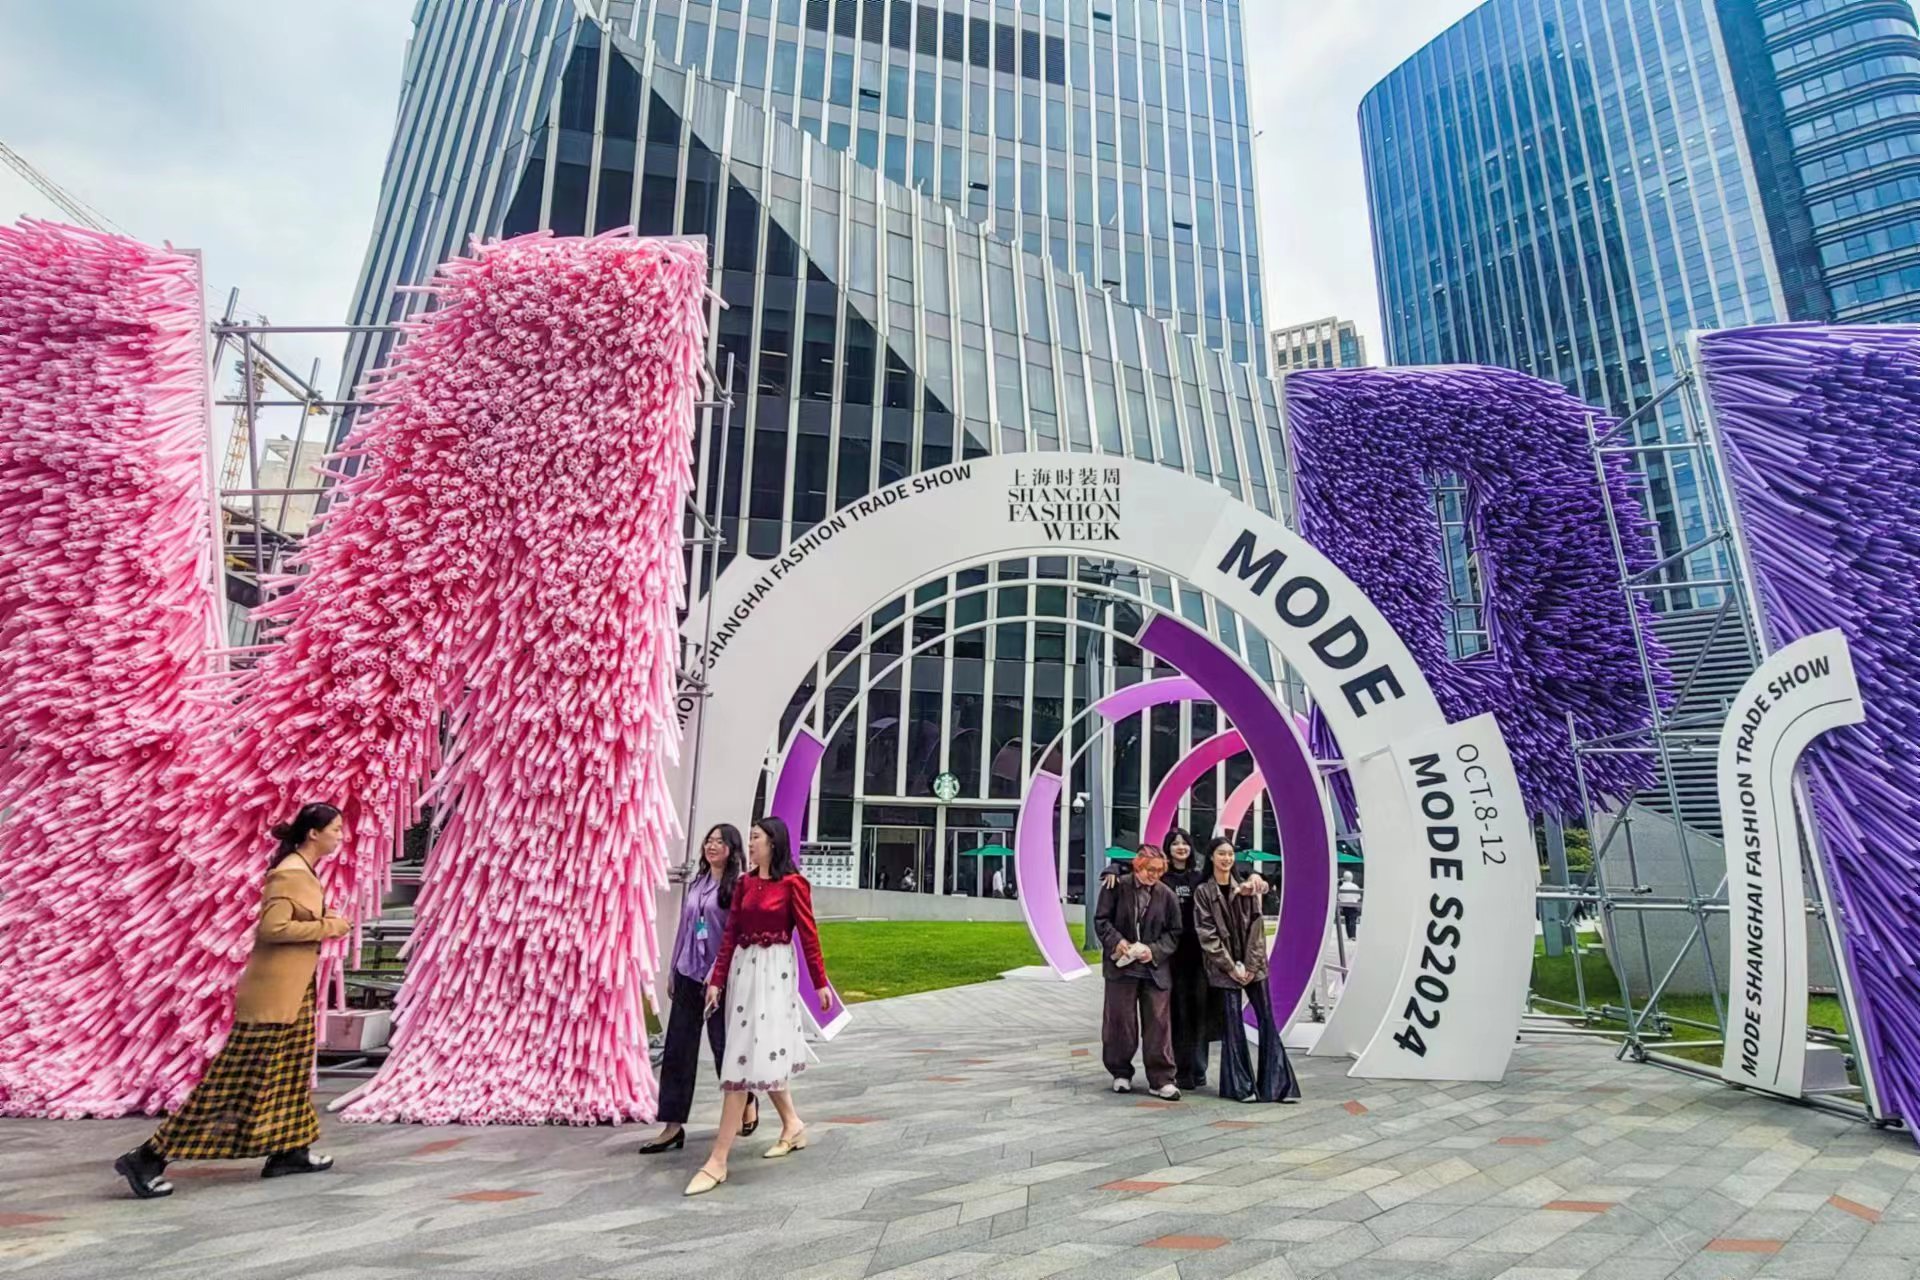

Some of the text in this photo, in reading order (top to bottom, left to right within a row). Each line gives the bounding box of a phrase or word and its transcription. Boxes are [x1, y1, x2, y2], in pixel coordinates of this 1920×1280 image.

[1008, 467, 1120, 487] 上海时装周
[1008, 487, 1120, 503] SHANGHAI
[1008, 503, 1120, 522] FASHION
[1042, 522, 1120, 541] WEEK
[700, 576, 774, 669] SHANGHAI
[770, 516, 847, 580] FASHION
[845, 484, 910, 522] TRADE
[912, 463, 971, 494] SHOW
[1217, 528, 1406, 718] MODE
[1456, 743, 1507, 865] OCT.8-12
[1393, 753, 1464, 1058] MODE SS2024
[1736, 655, 1831, 1078] MODE SHANGHAI FASHION TRADE SHOW
